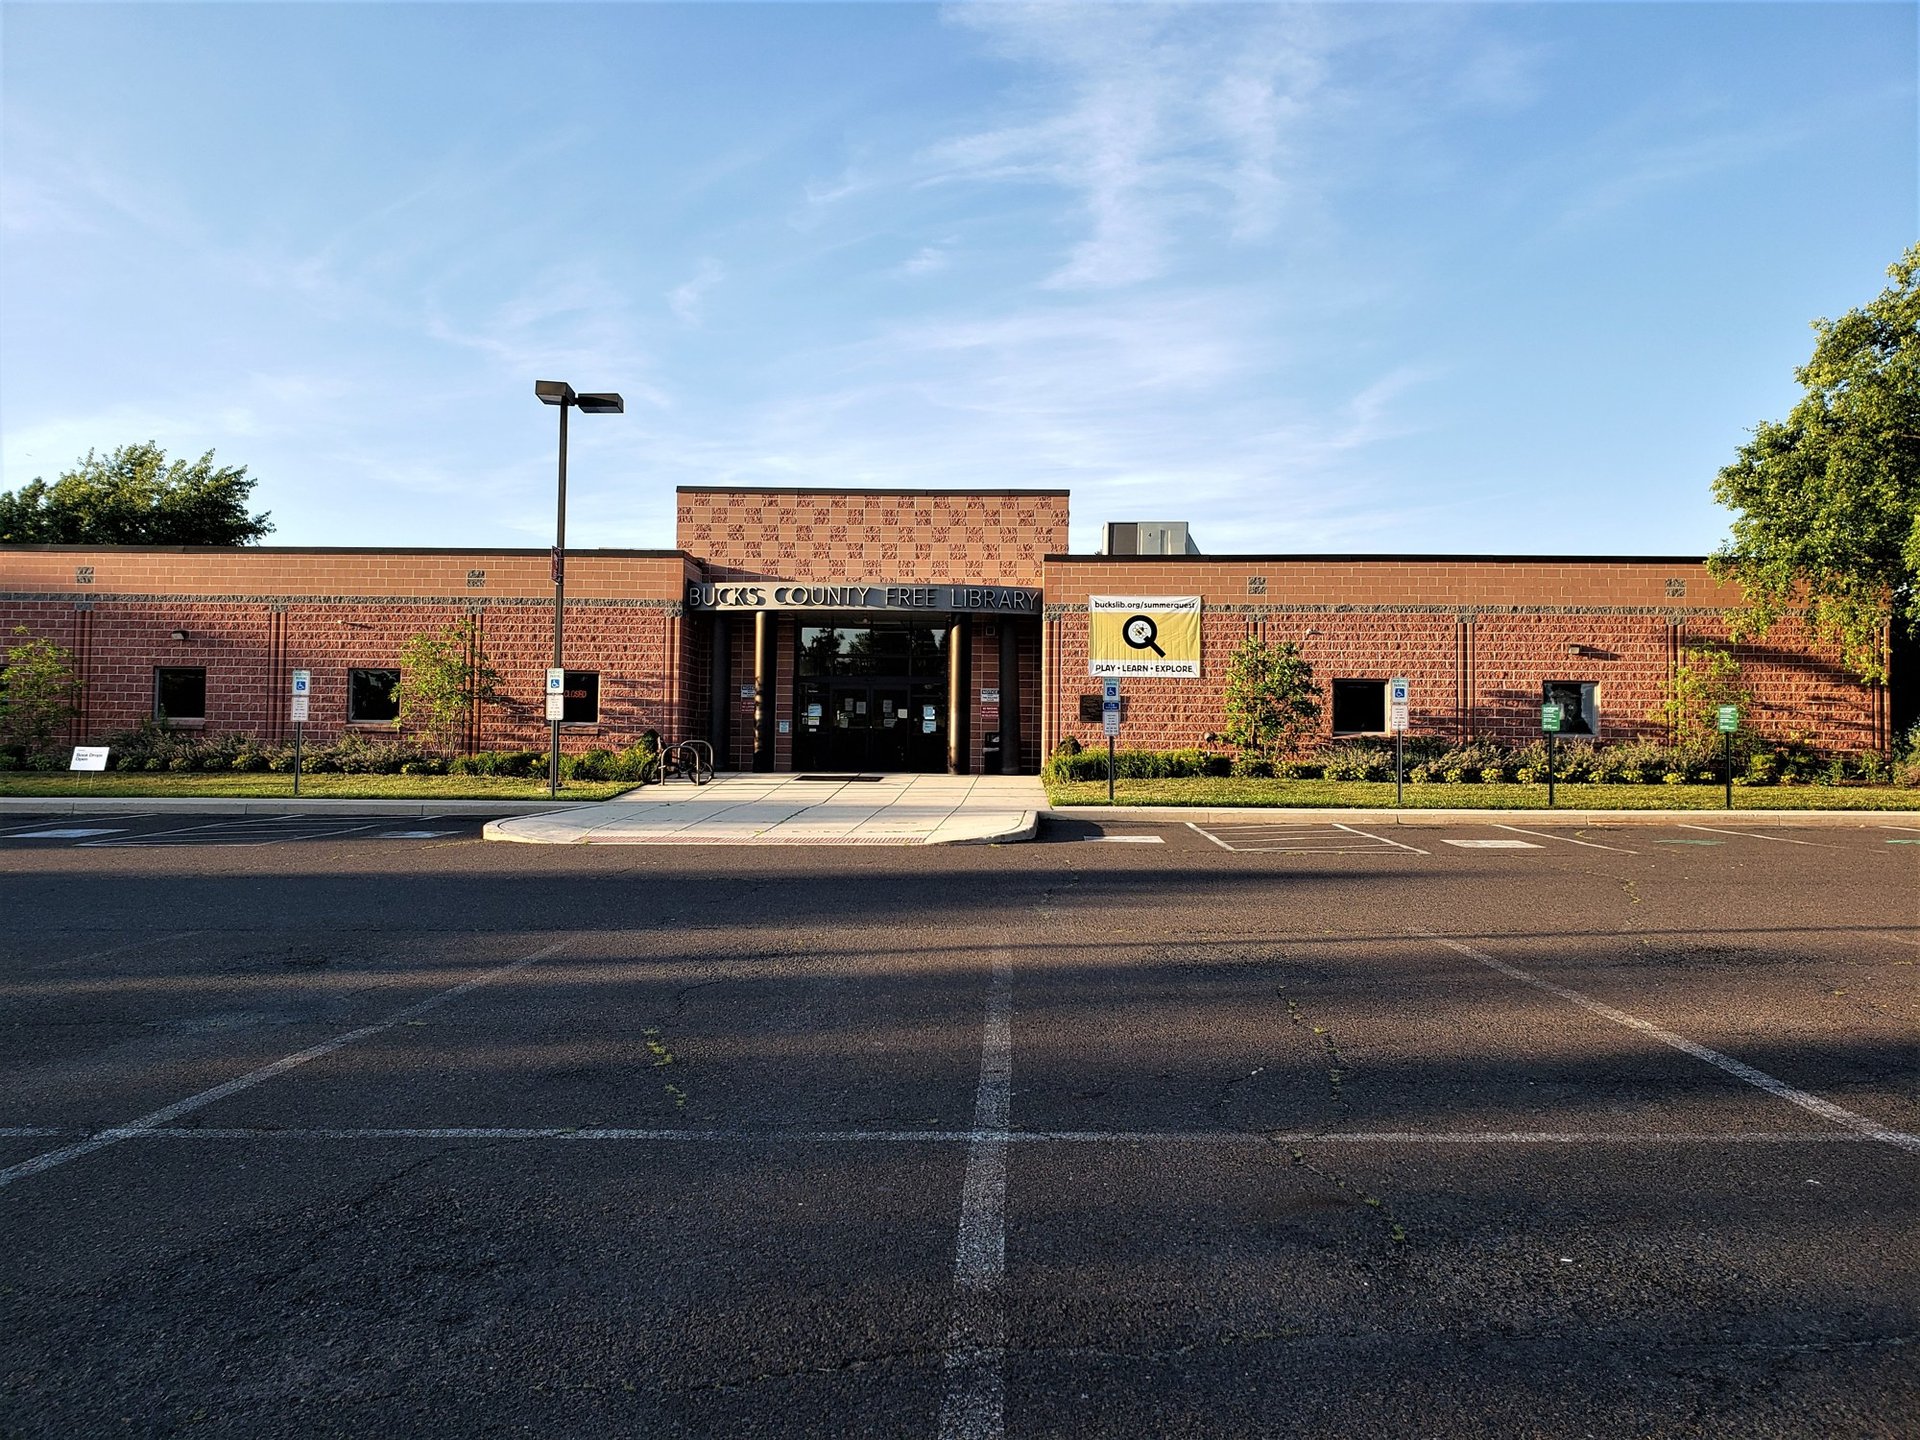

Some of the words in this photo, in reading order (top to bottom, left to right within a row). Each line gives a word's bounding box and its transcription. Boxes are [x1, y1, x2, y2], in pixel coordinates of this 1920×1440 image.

[689, 587, 759, 606] BUCKS
[774, 586, 870, 606] COUNTY
[885, 587, 937, 607] FREE
[951, 588, 1039, 610] LIBRARY
[1094, 601, 1195, 609] buckslib.org/summerquest
[1095, 664, 1116, 672] PLAY
[1155, 665, 1193, 673] EXPLORE
